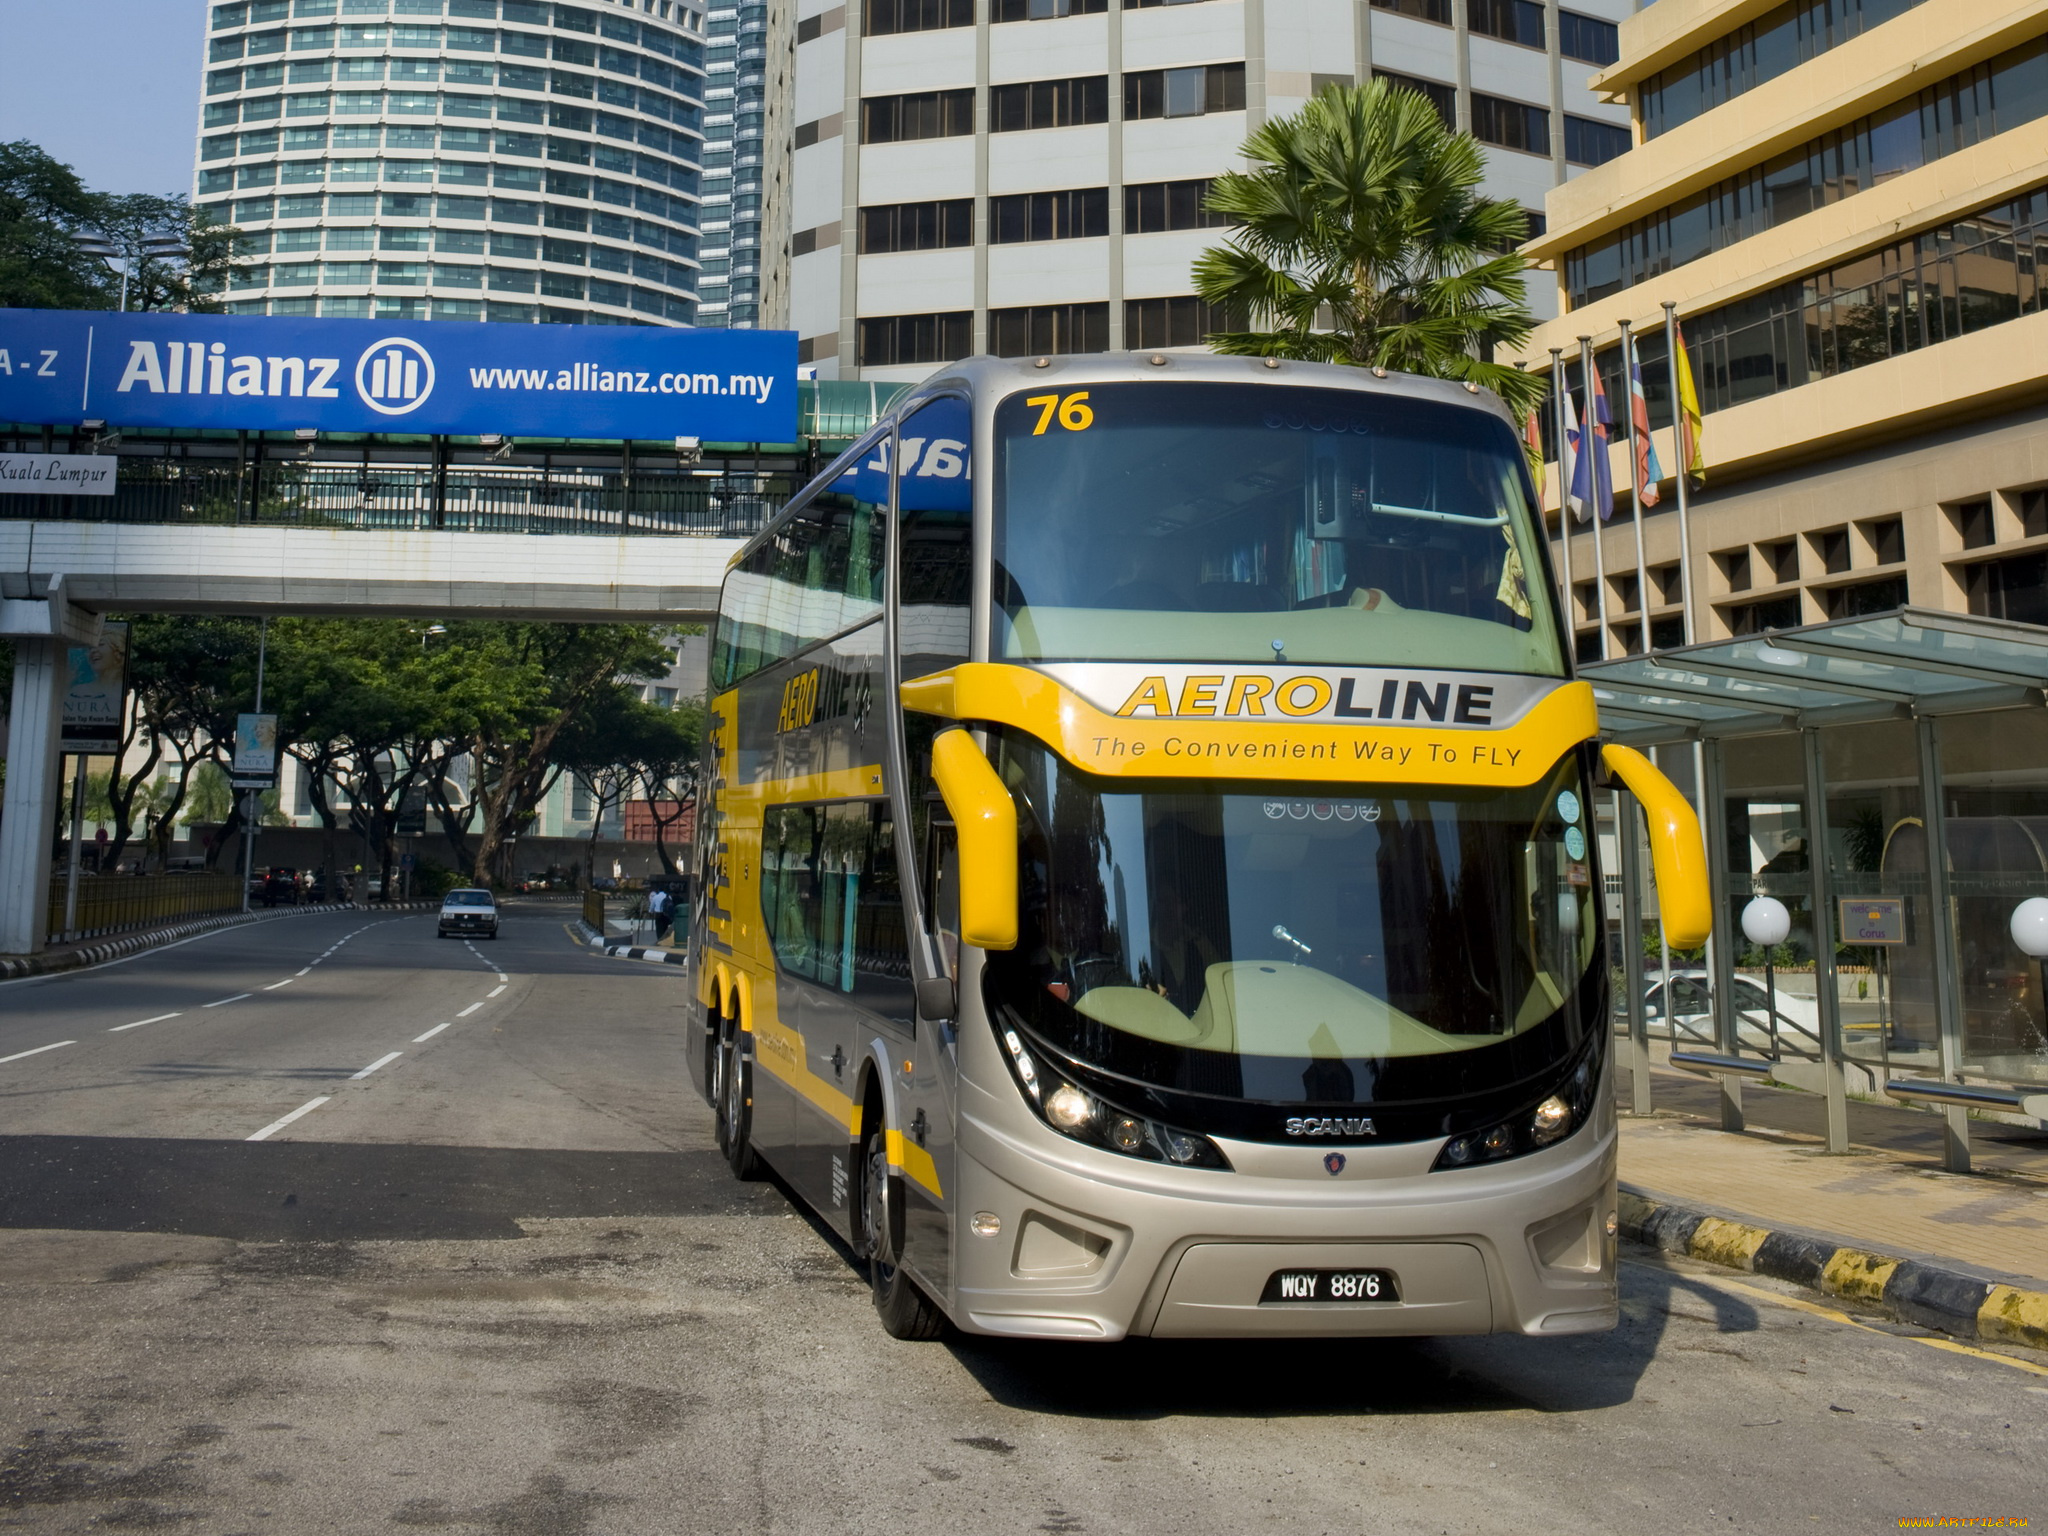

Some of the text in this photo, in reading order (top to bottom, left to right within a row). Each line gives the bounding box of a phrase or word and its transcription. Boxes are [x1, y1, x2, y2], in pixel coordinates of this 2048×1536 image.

[117, 340, 340, 398] Allianz
[470, 362, 775, 404] www.allianz.com.my
[1026, 391, 1094, 436] 76
[0, 460, 107, 488] Kuala Lumpur
[63, 701, 112, 713] NURA
[776, 657, 854, 736] AEROLINE
[1114, 675, 1494, 726] AEROLINE
[1092, 737, 1521, 767] The Convenient Way To FLY
[1850, 903, 1892, 914] welcme
[1858, 928, 1886, 938] Corus
[1286, 1118, 1377, 1136] SCANIA
[1281, 1274, 1380, 1298] WQY 8876
